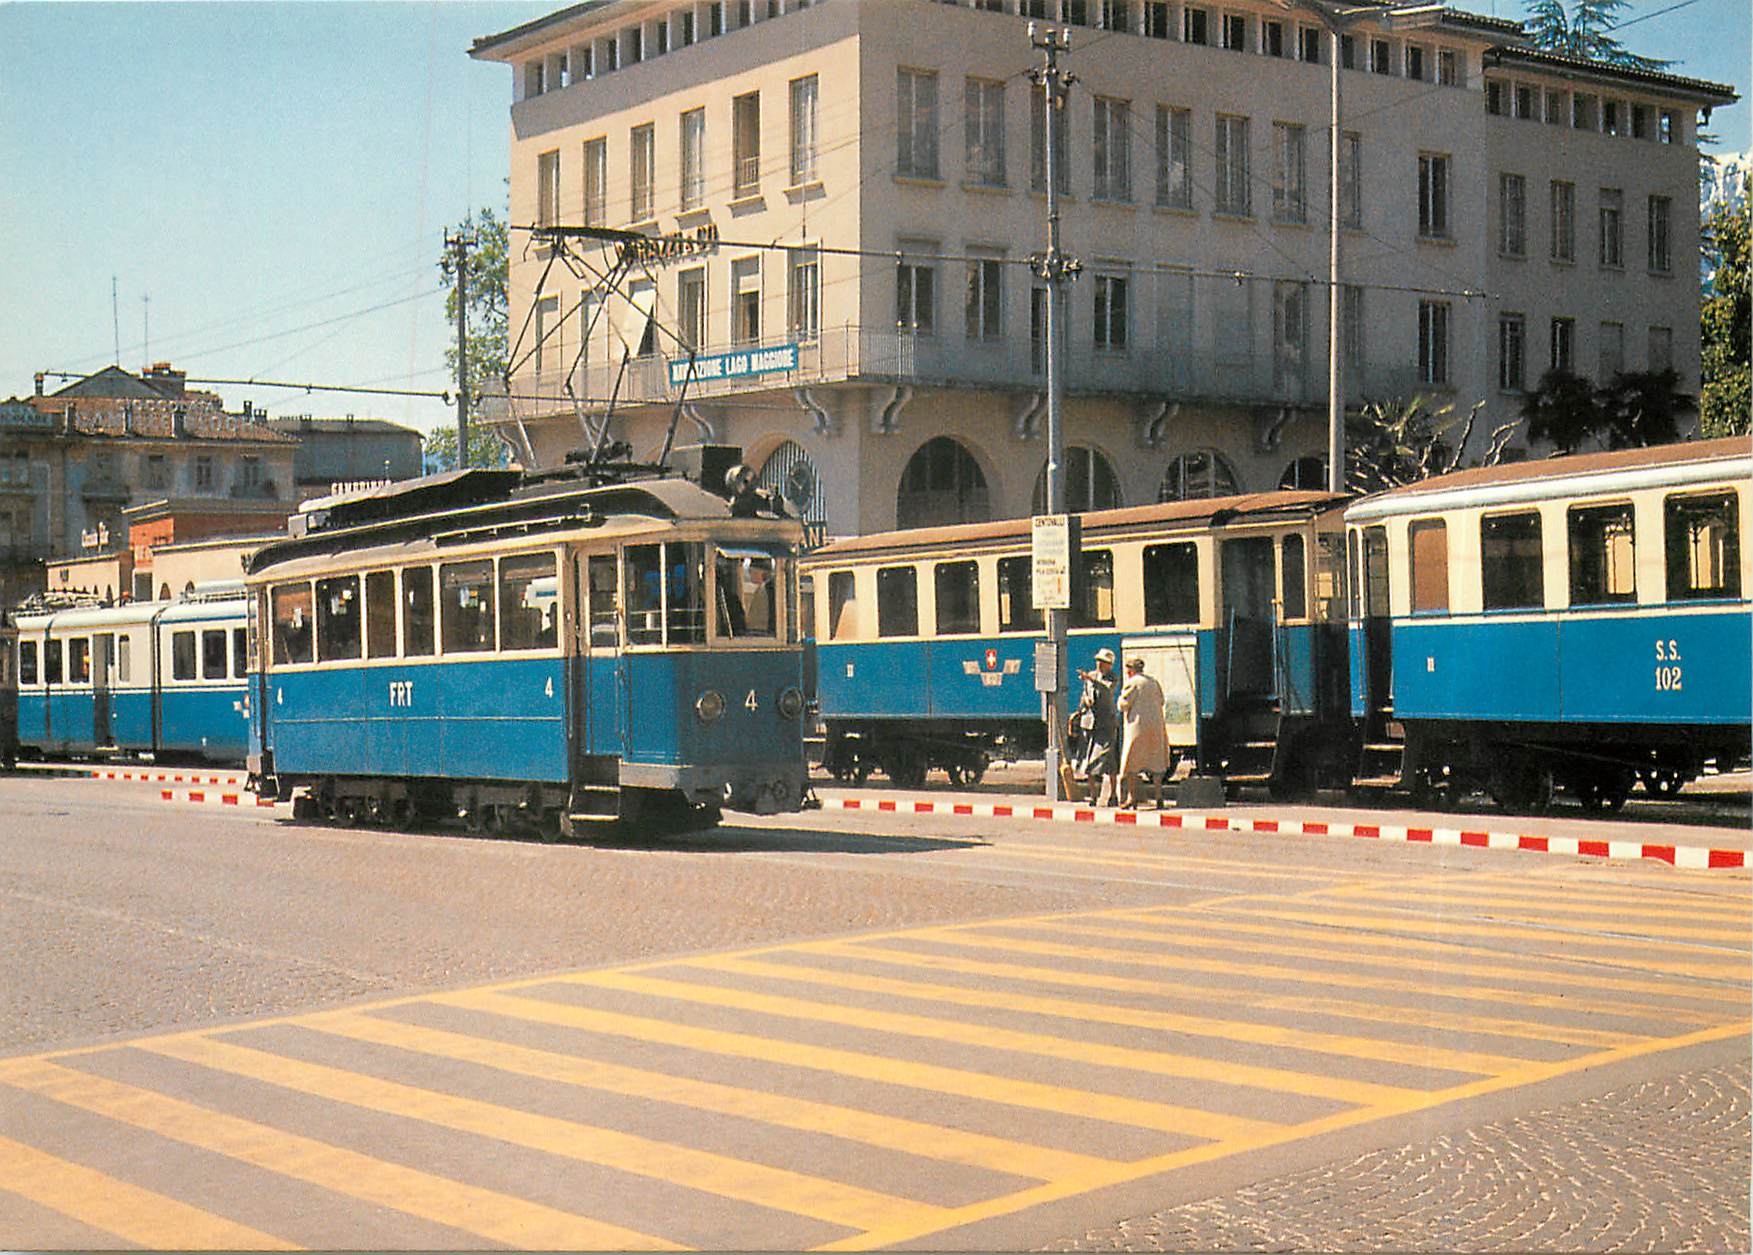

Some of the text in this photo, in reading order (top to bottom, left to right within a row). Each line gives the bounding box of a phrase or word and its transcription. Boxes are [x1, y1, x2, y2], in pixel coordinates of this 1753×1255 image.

[725, 354, 747, 375] LAGO
[751, 349, 794, 371] MAGGIORE
[1656, 639, 1681, 660] S.S.
[544, 676, 554, 699] 4
[1655, 666, 1682, 690] 102
[277, 687, 284, 705] 4
[389, 681, 414, 707] FRT
[745, 689, 759, 711] 4
